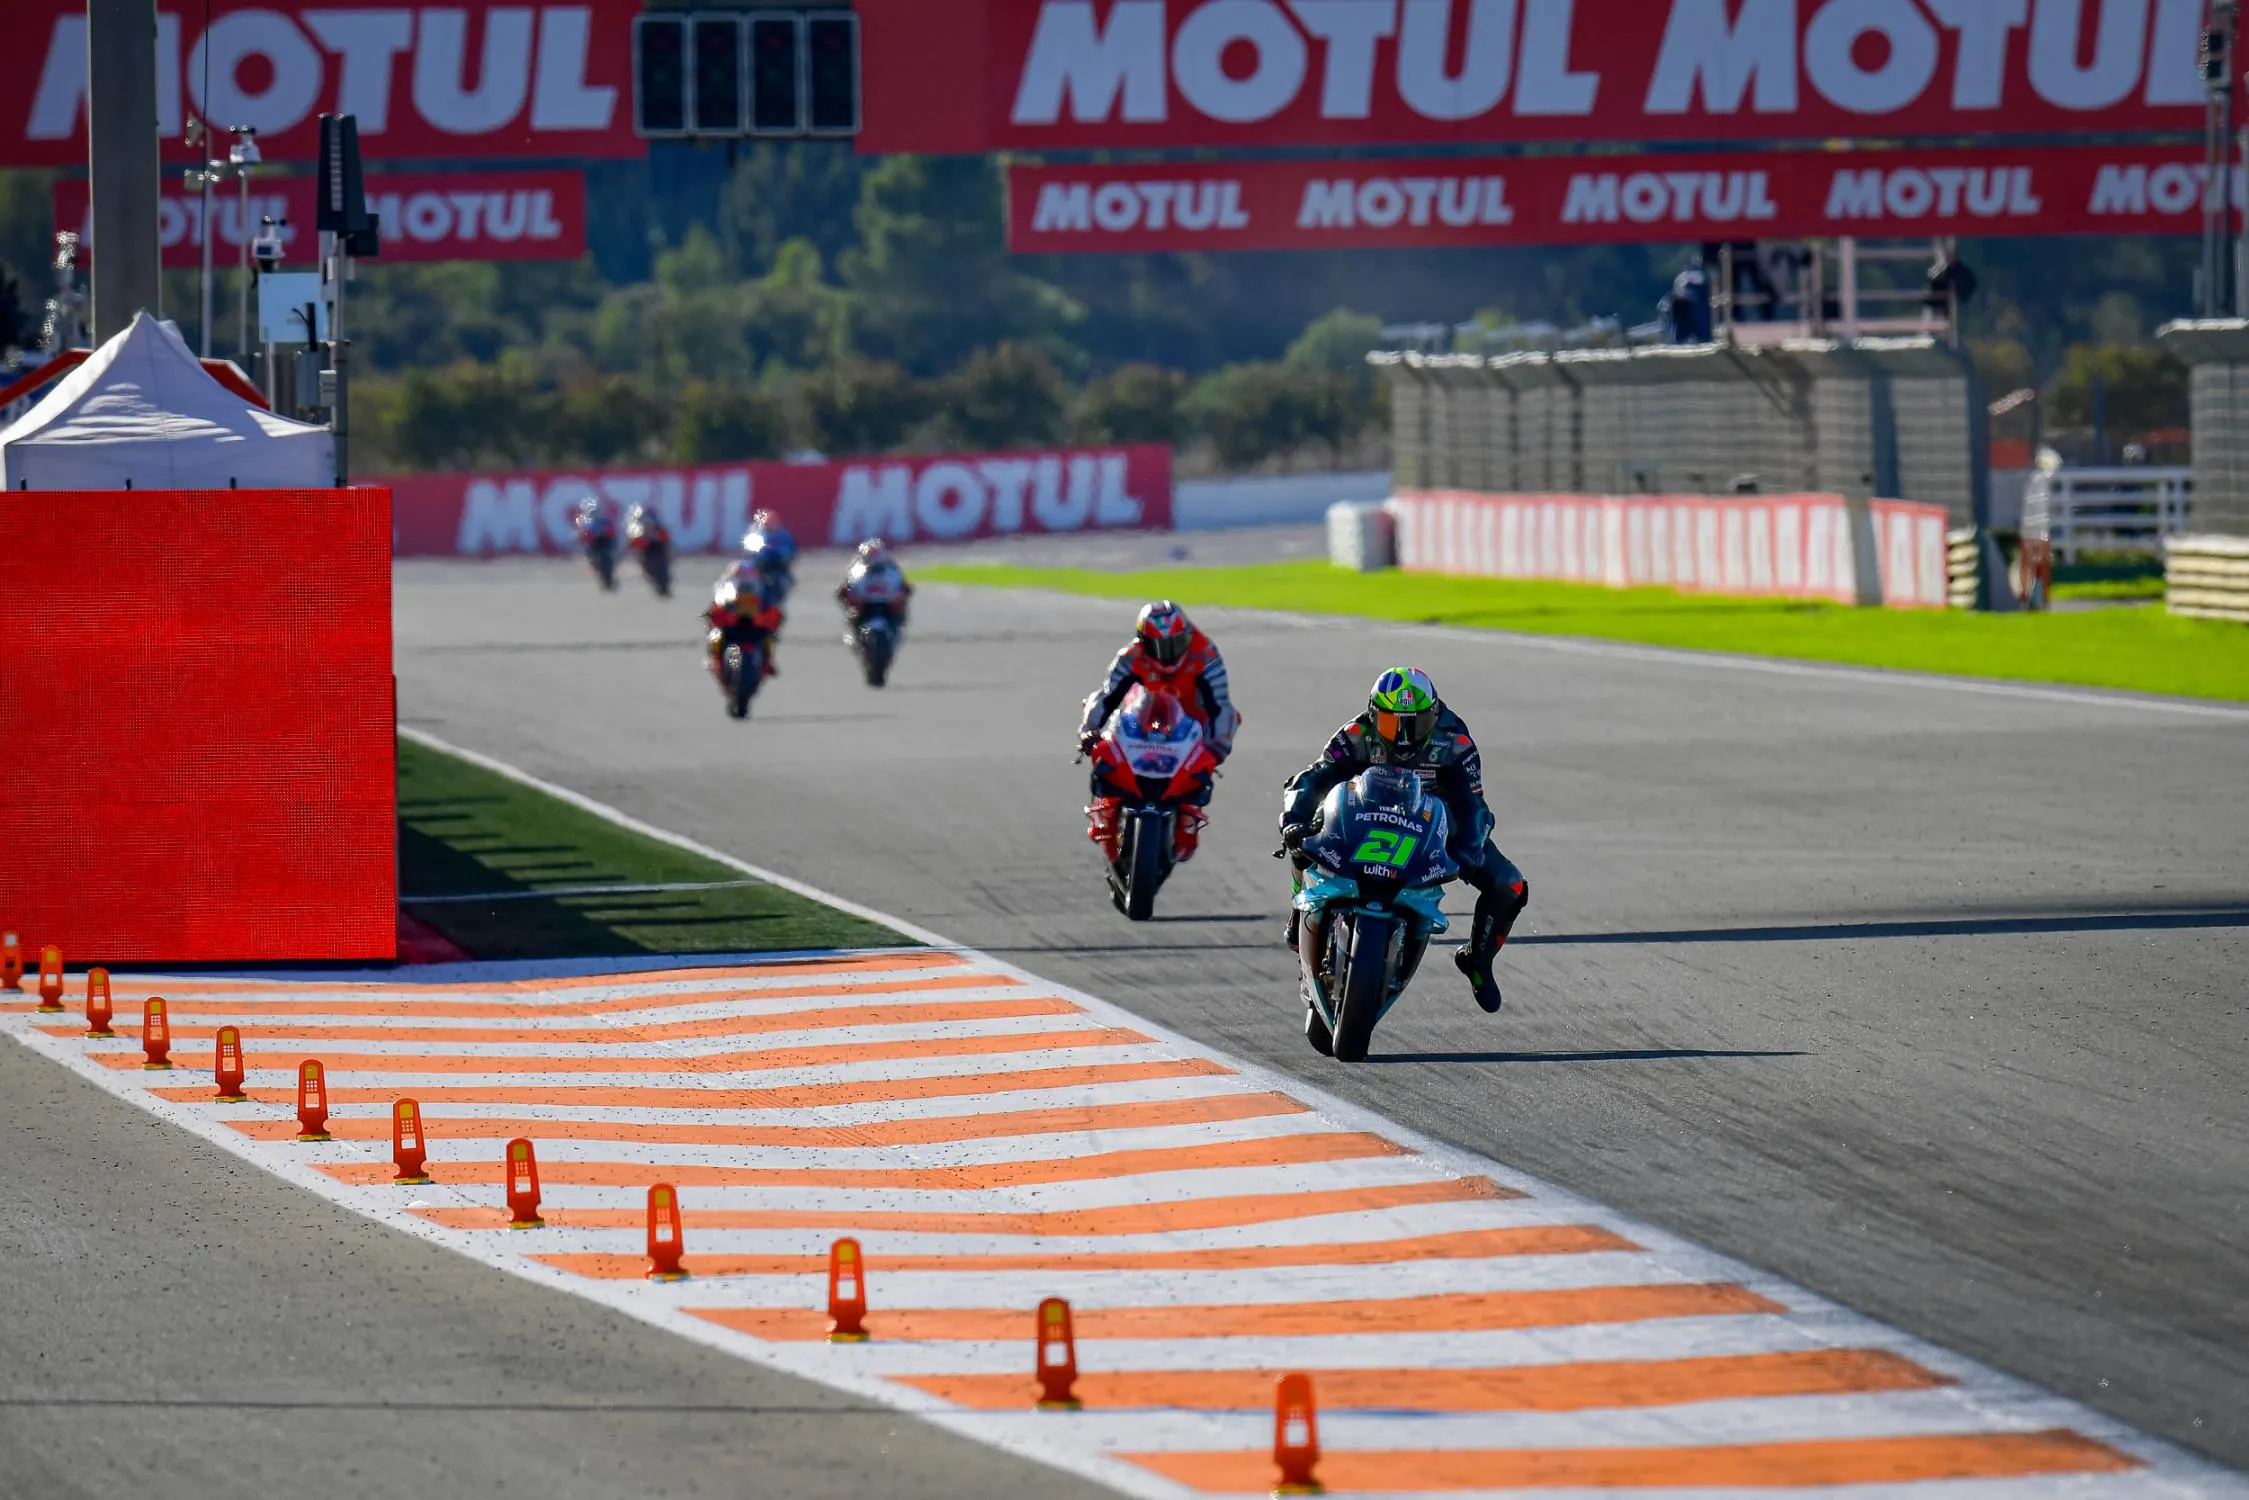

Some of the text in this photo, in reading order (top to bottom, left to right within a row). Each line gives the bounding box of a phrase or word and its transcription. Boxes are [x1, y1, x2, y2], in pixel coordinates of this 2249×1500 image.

[26, 4, 617, 140] MOTUL
[1010, 0, 2220, 125] MOTUL MOTUL
[81, 193, 295, 249] OTUL
[1032, 180, 1249, 231] MOTUL
[1296, 176, 1514, 228] MOTUL
[1561, 170, 1776, 223] MOTUL
[1824, 166, 2041, 219] MOTUL
[457, 452, 1144, 553] MOTUL MOTUL
[1354, 830, 1416, 866] 21
[1355, 812, 1423, 833] PETRONAS
